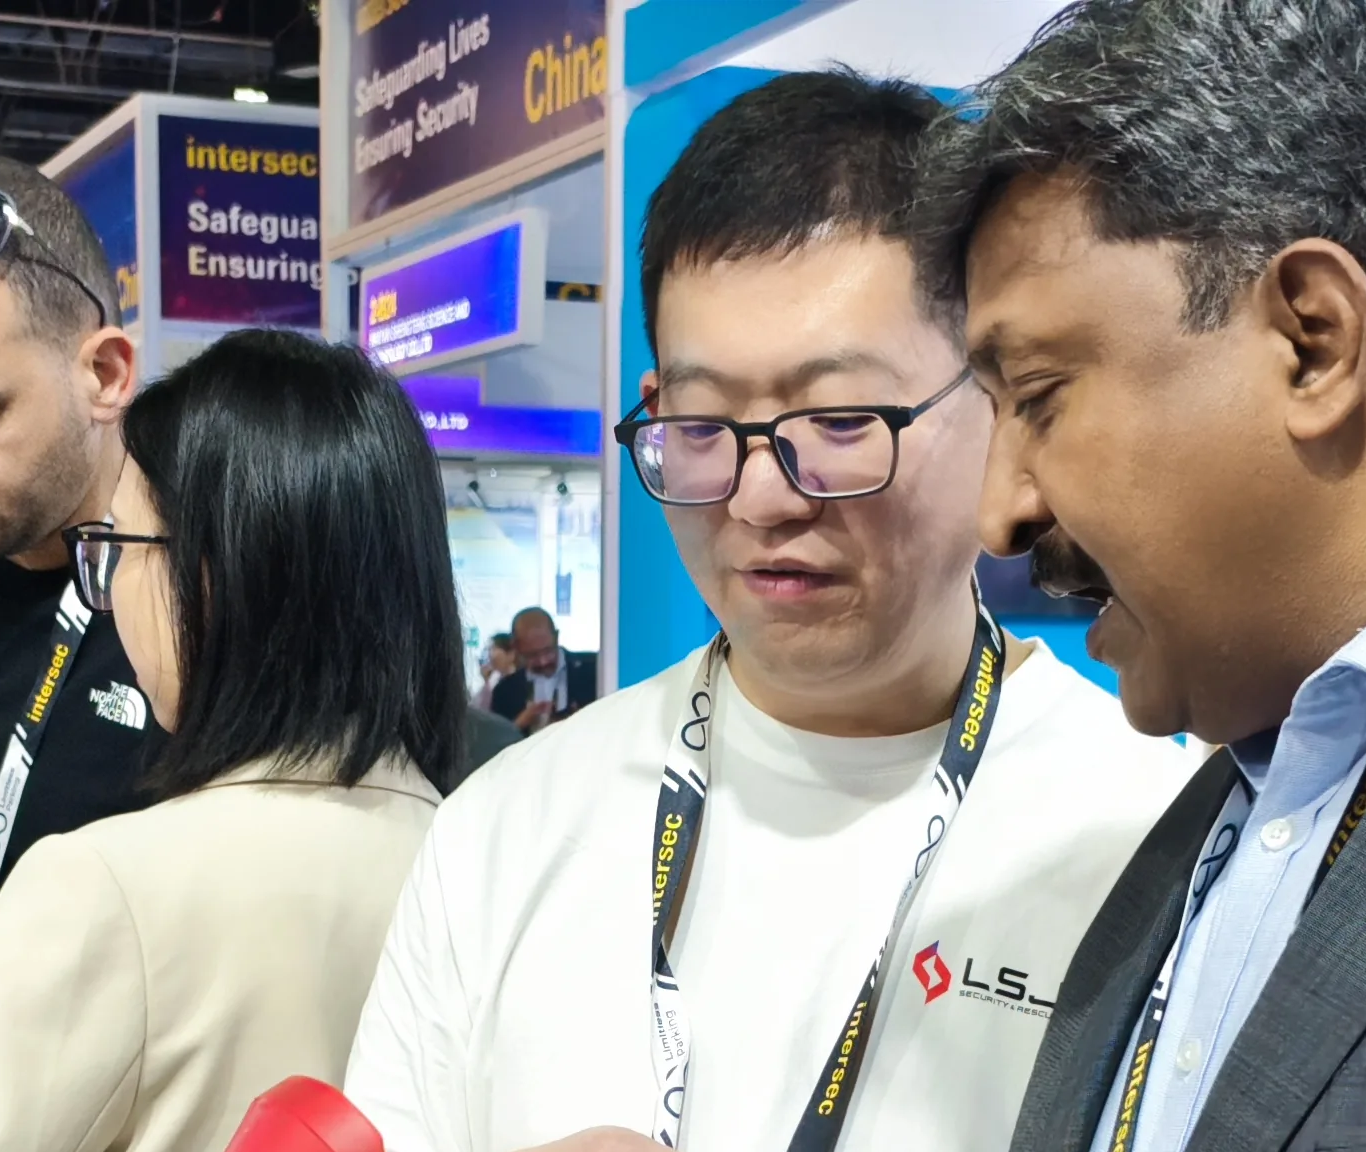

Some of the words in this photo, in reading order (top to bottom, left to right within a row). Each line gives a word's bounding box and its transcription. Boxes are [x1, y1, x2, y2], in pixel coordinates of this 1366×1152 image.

[355, 41, 446, 117] Safeguarding
[449, 14, 490, 64] Lives
[525, 34, 608, 123] China
[186, 136, 317, 177] intersec
[355, 118, 414, 174] Ensuring
[416, 80, 479, 142] Security
[188, 244, 323, 291] Ensuring
[27, 644, 69, 723] intersec
[89, 688, 125, 710] NORTH
[96, 705, 122, 721] FACE
[110, 681, 128, 697] THE
[960, 647, 997, 751] intersec
[652, 813, 683, 926] ntersec
[654, 1003, 672, 1062] Limitless
[959, 990, 1009, 1008] SECURITY
[817, 1001, 867, 1117] intersec
